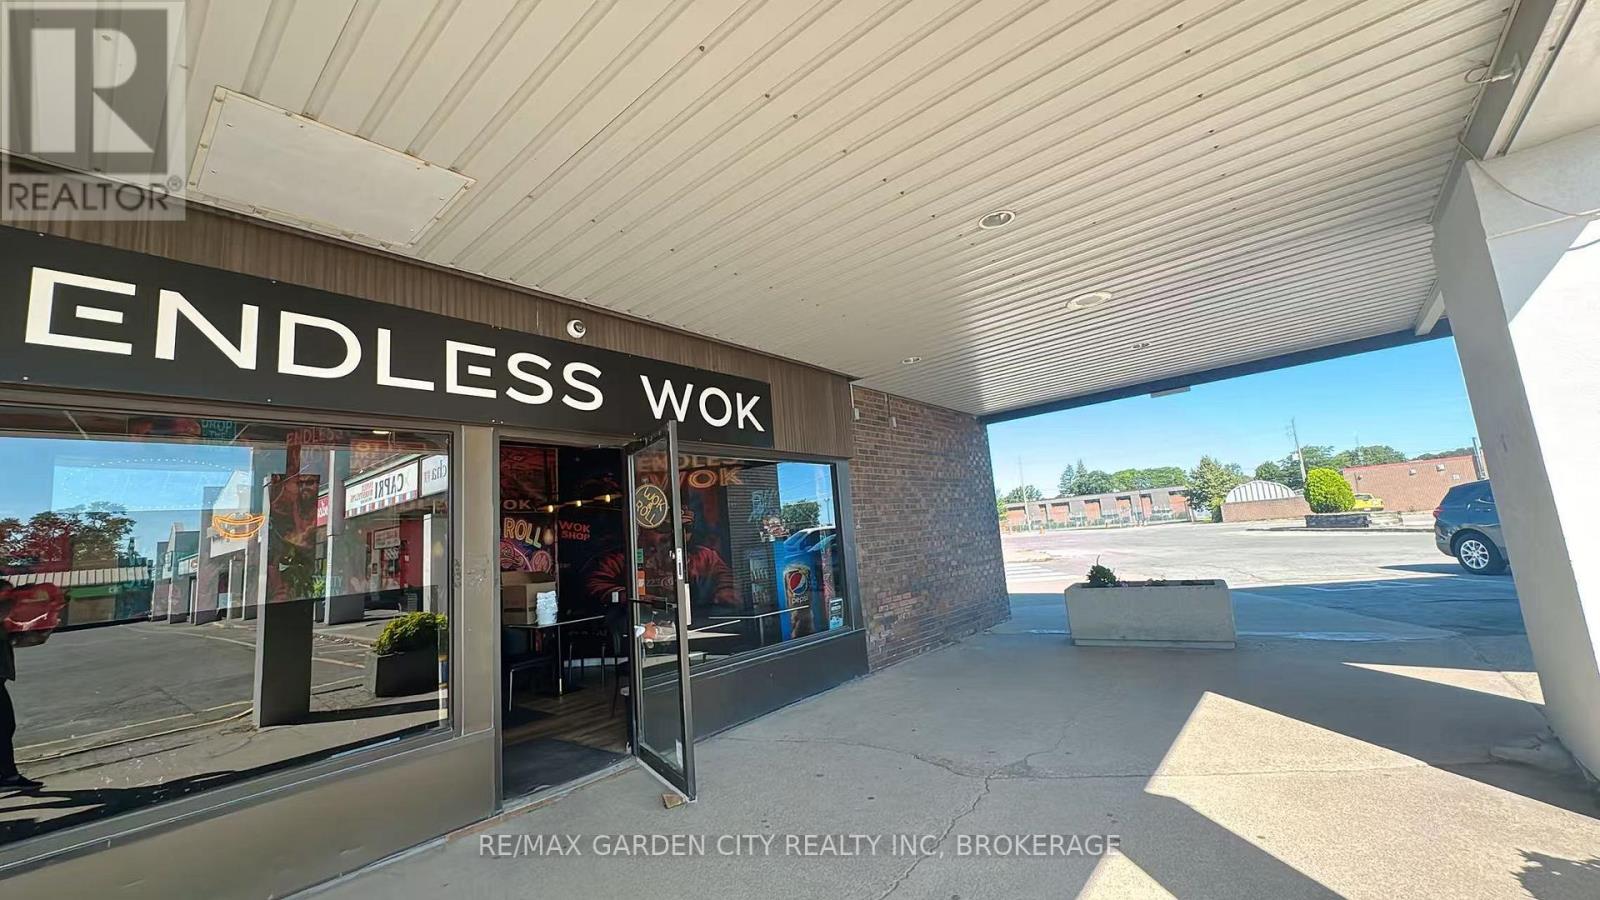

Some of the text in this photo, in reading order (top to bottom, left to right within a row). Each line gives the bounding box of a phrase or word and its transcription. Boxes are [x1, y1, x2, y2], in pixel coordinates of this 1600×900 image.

[25, 267, 766, 432] ENDLESS WOK
[642, 487, 665, 512] WOK
[636, 500, 656, 526] ROLL
[503, 517, 542, 549] ROLL
[559, 520, 591, 533] WOK
[561, 530, 591, 541] SHOP
